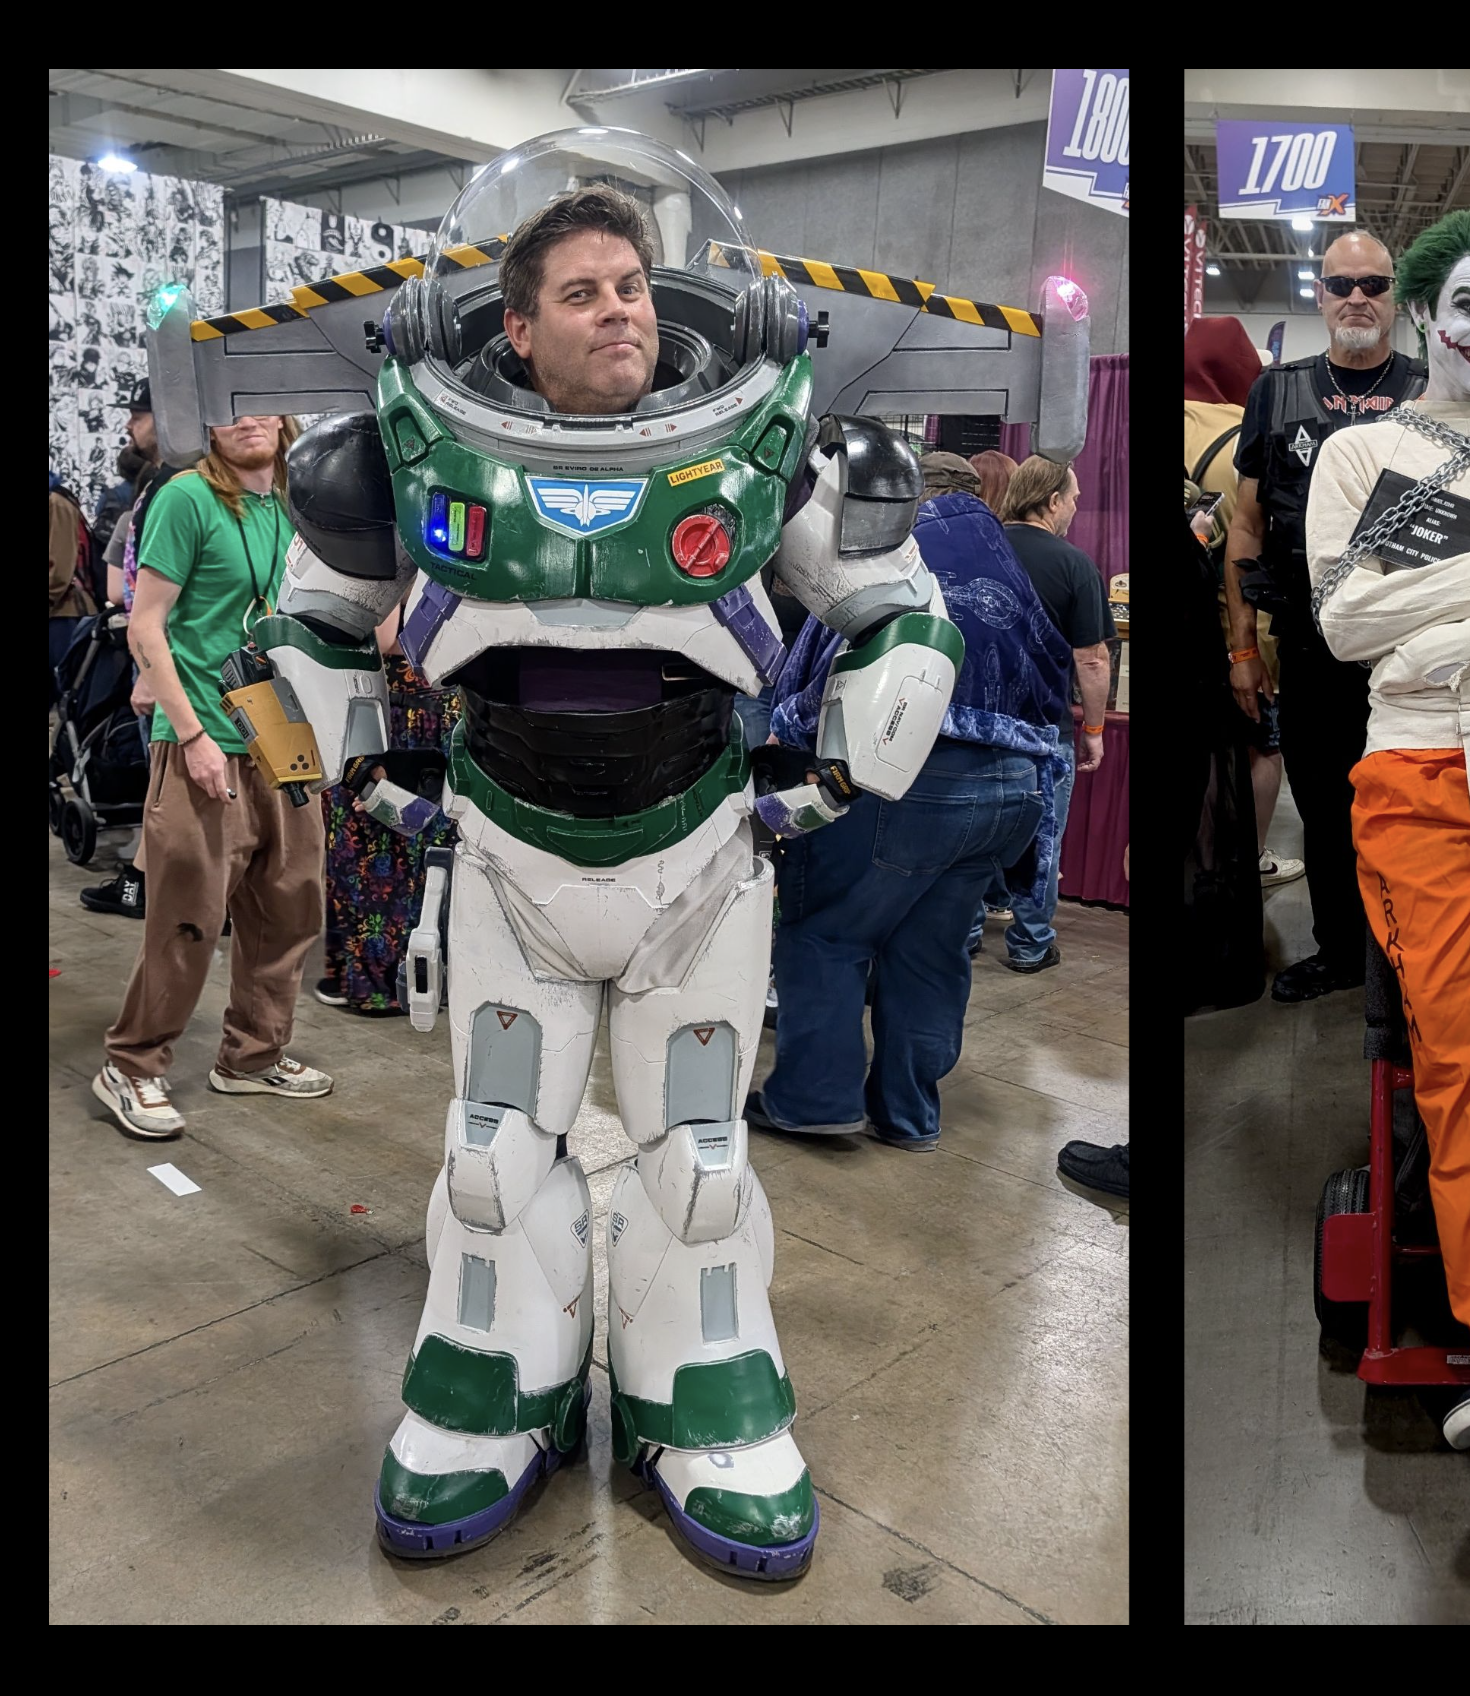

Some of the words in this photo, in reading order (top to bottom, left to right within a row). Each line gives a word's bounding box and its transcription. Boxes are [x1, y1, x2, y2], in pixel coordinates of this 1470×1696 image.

[1238, 131, 1337, 195] 1700
[669, 460, 724, 485] LIGHTYEAR
[1384, 540, 1404, 553] OTHAM
[1405, 546, 1419, 557] CITY
[430, 561, 477, 580] TACTICAL
[830, 765, 844, 784] FIRM
[1376, 870, 1423, 1046] ARKHAM
[469, 1113, 499, 1125] ACCESS
[697, 1136, 728, 1145] ACCESS
